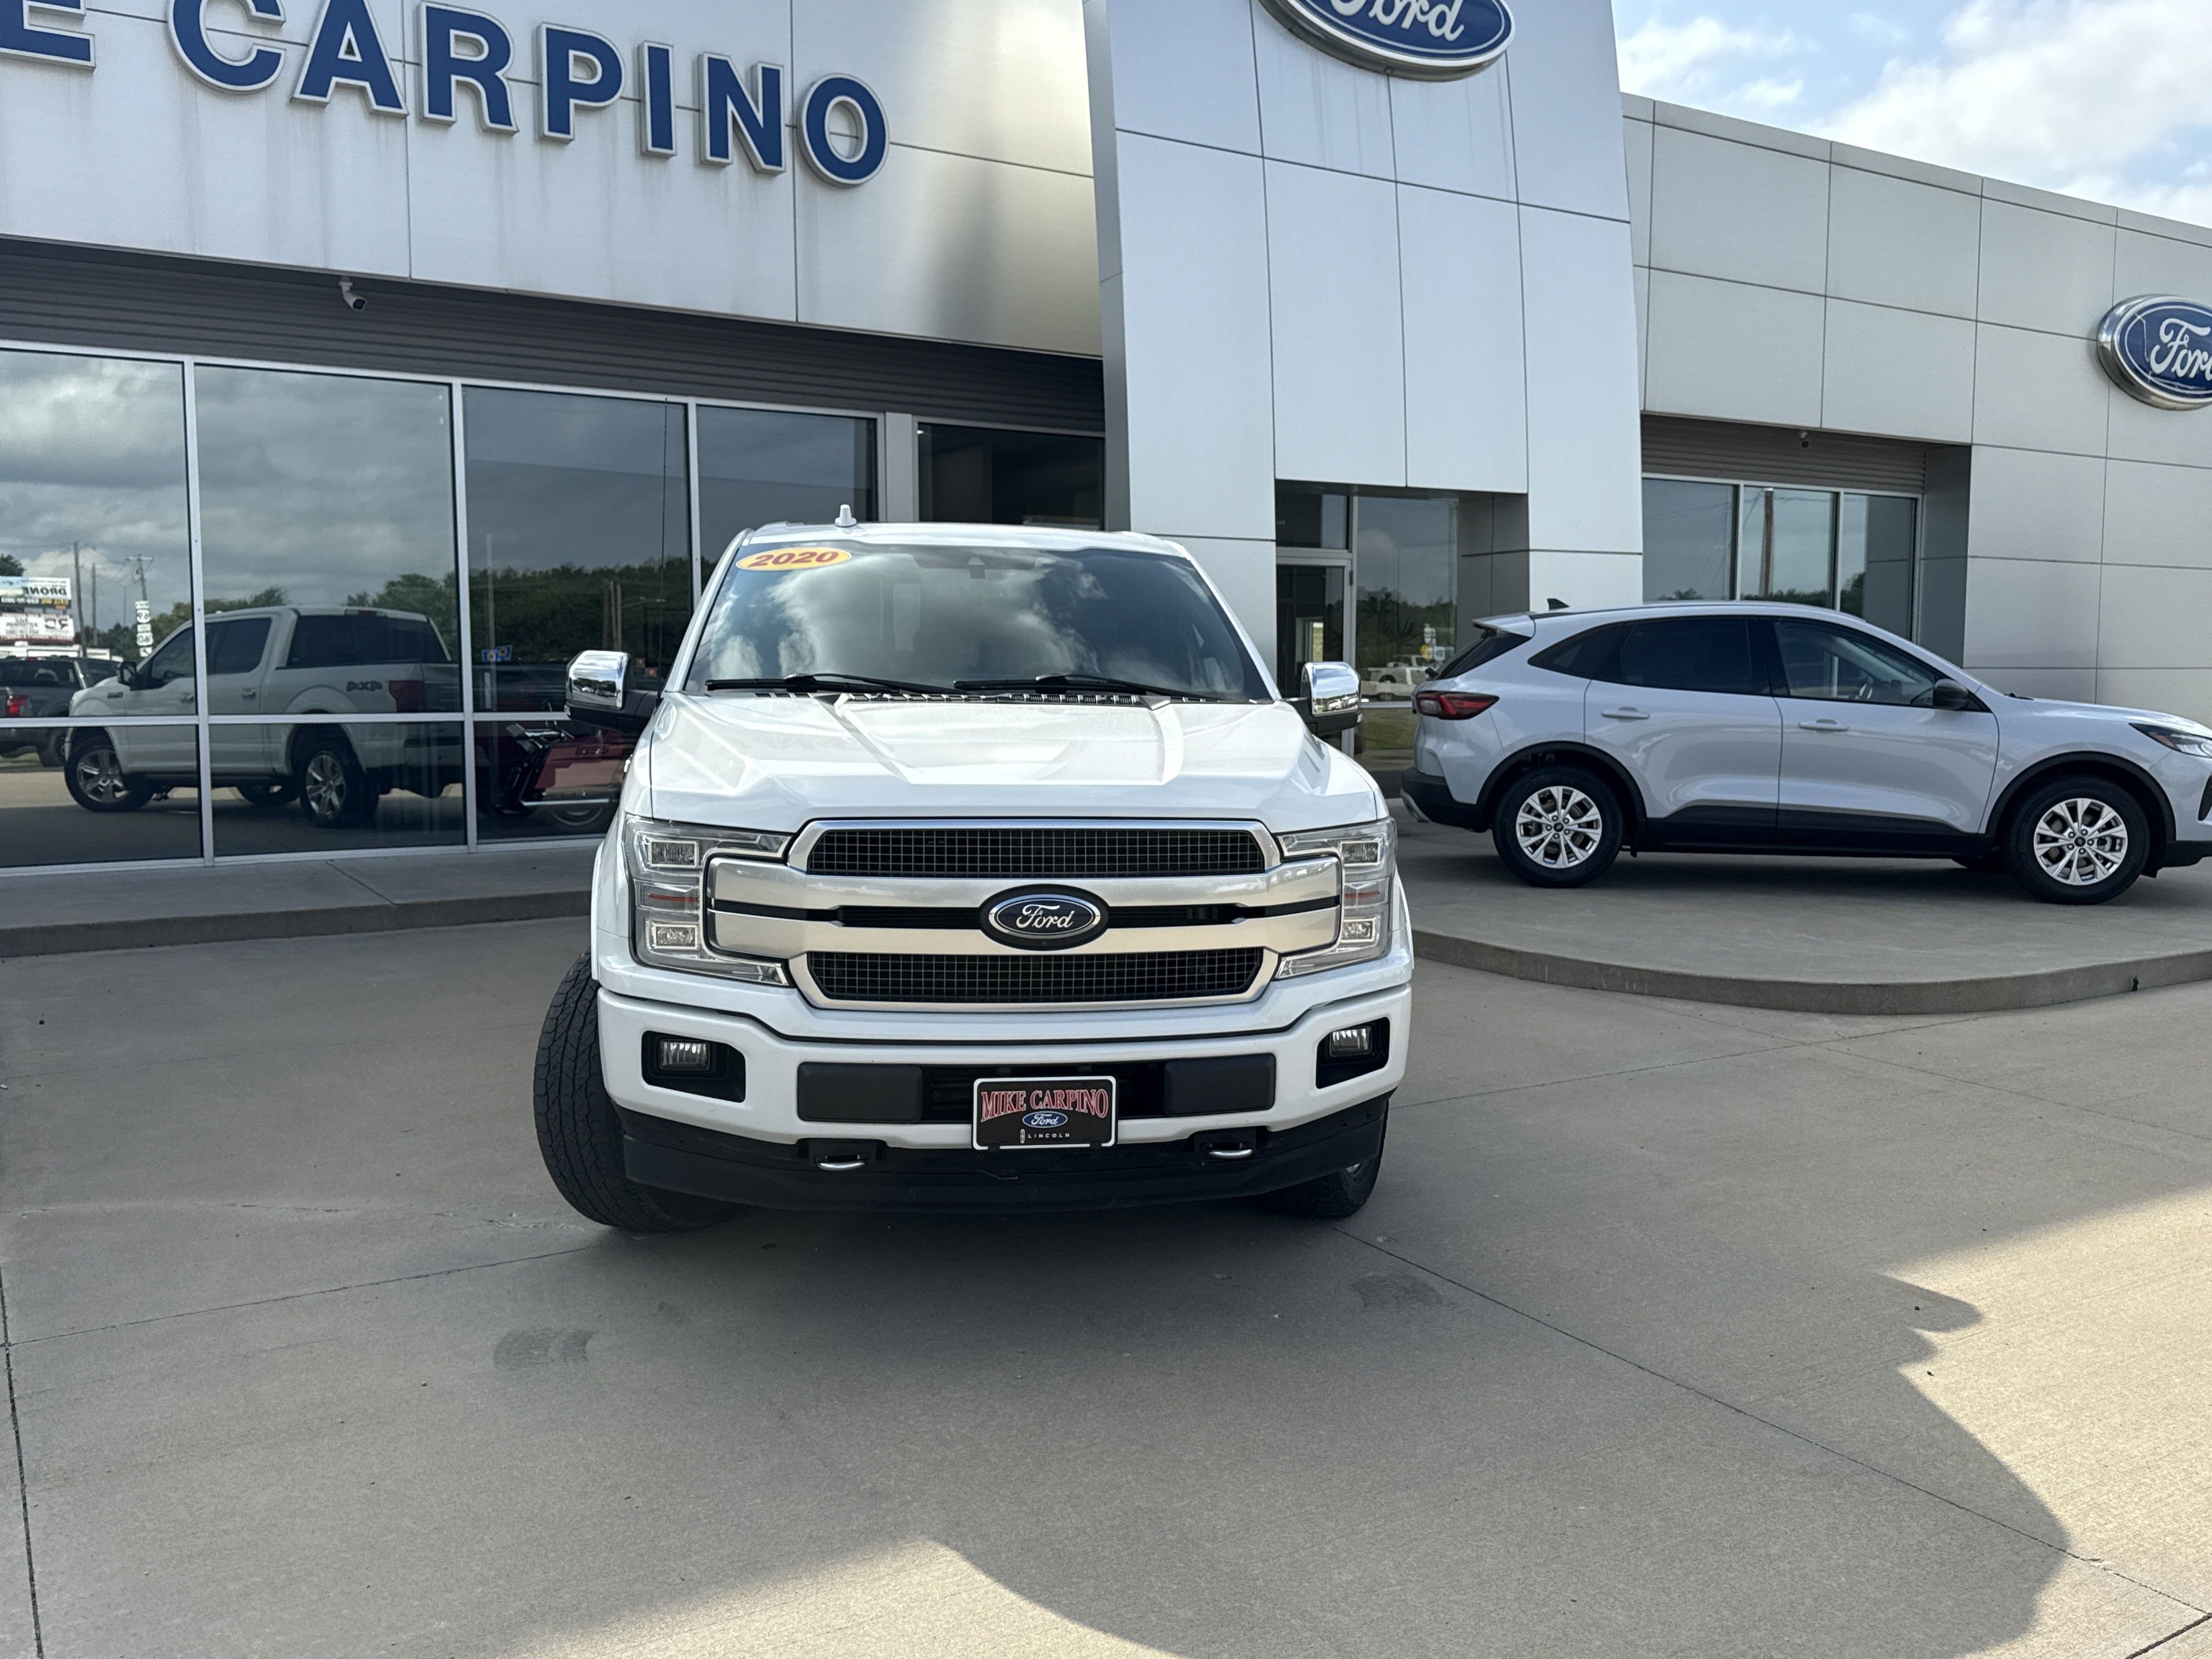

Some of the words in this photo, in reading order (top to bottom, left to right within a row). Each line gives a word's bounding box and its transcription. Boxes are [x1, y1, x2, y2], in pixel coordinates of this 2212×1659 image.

[1328, 0, 1464, 42] ord
[167, 0, 890, 187] CARPINO
[2150, 318, 2212, 381] For
[747, 551, 839, 567] 2020
[1016, 904, 1075, 928] Ford
[981, 1091, 1026, 1122] MIKE
[1029, 1088, 1109, 1118] CARPINO
[1030, 1113, 1059, 1125] Ford
